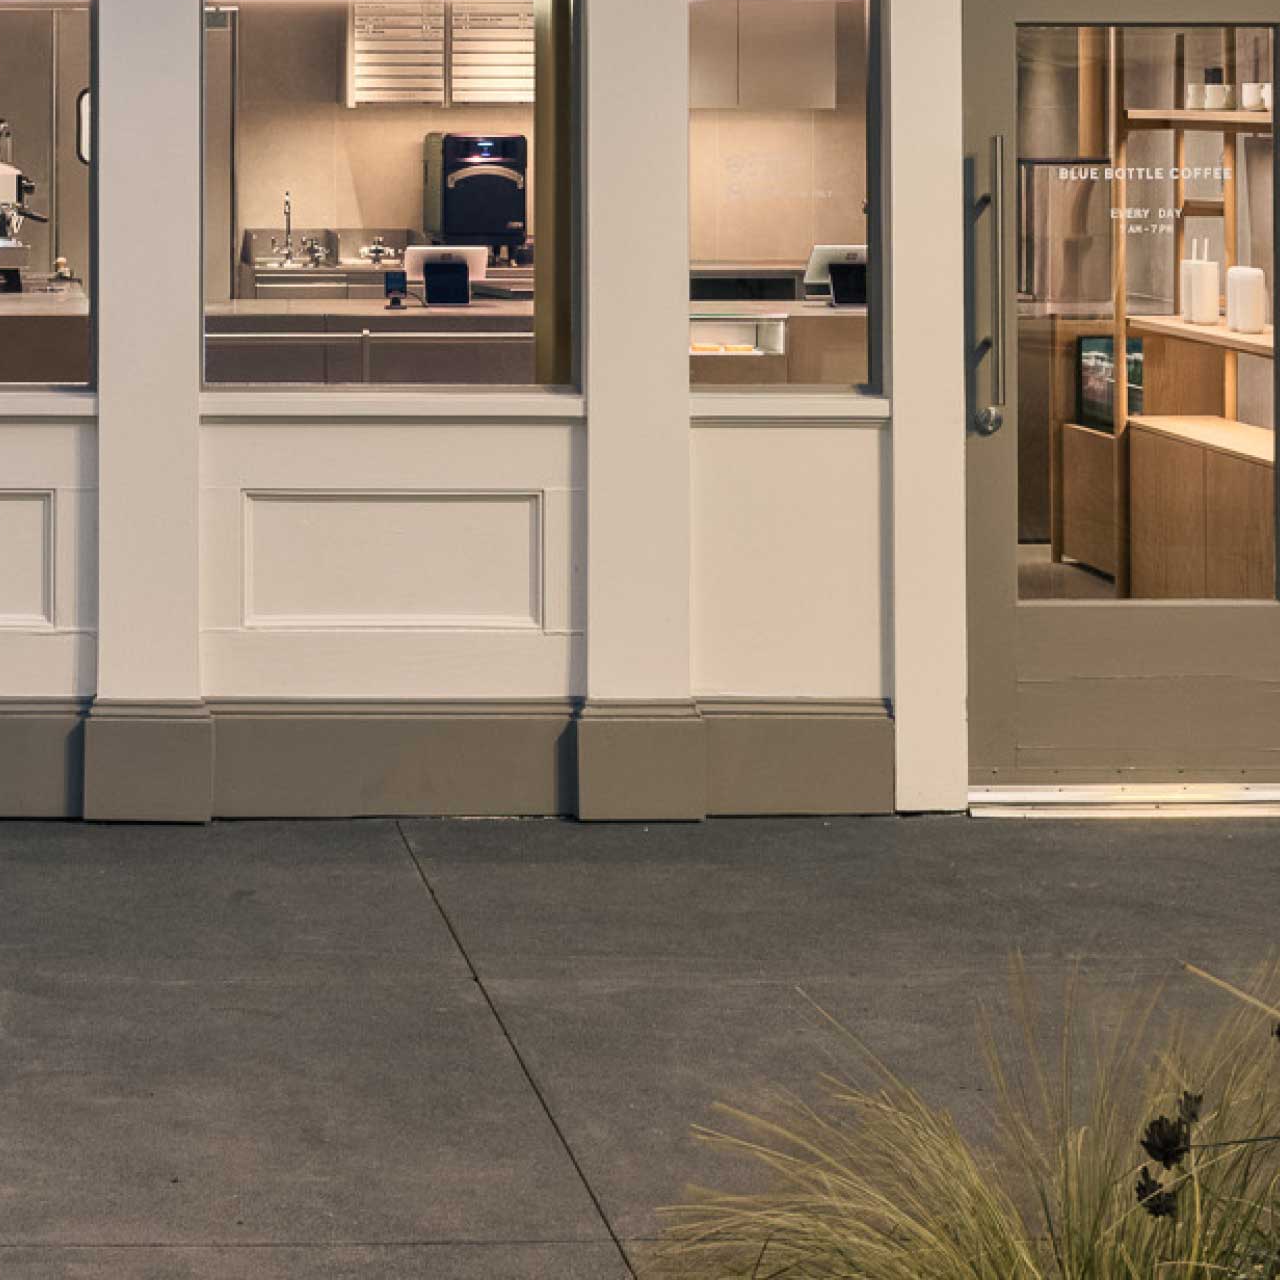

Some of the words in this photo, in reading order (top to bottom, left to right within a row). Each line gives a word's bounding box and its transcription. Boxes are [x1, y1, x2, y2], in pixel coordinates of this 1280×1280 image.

[1058, 167, 1099, 180] BLUE
[1104, 167, 1164, 180] BOTTLE
[1169, 167, 1233, 180] COFFEE
